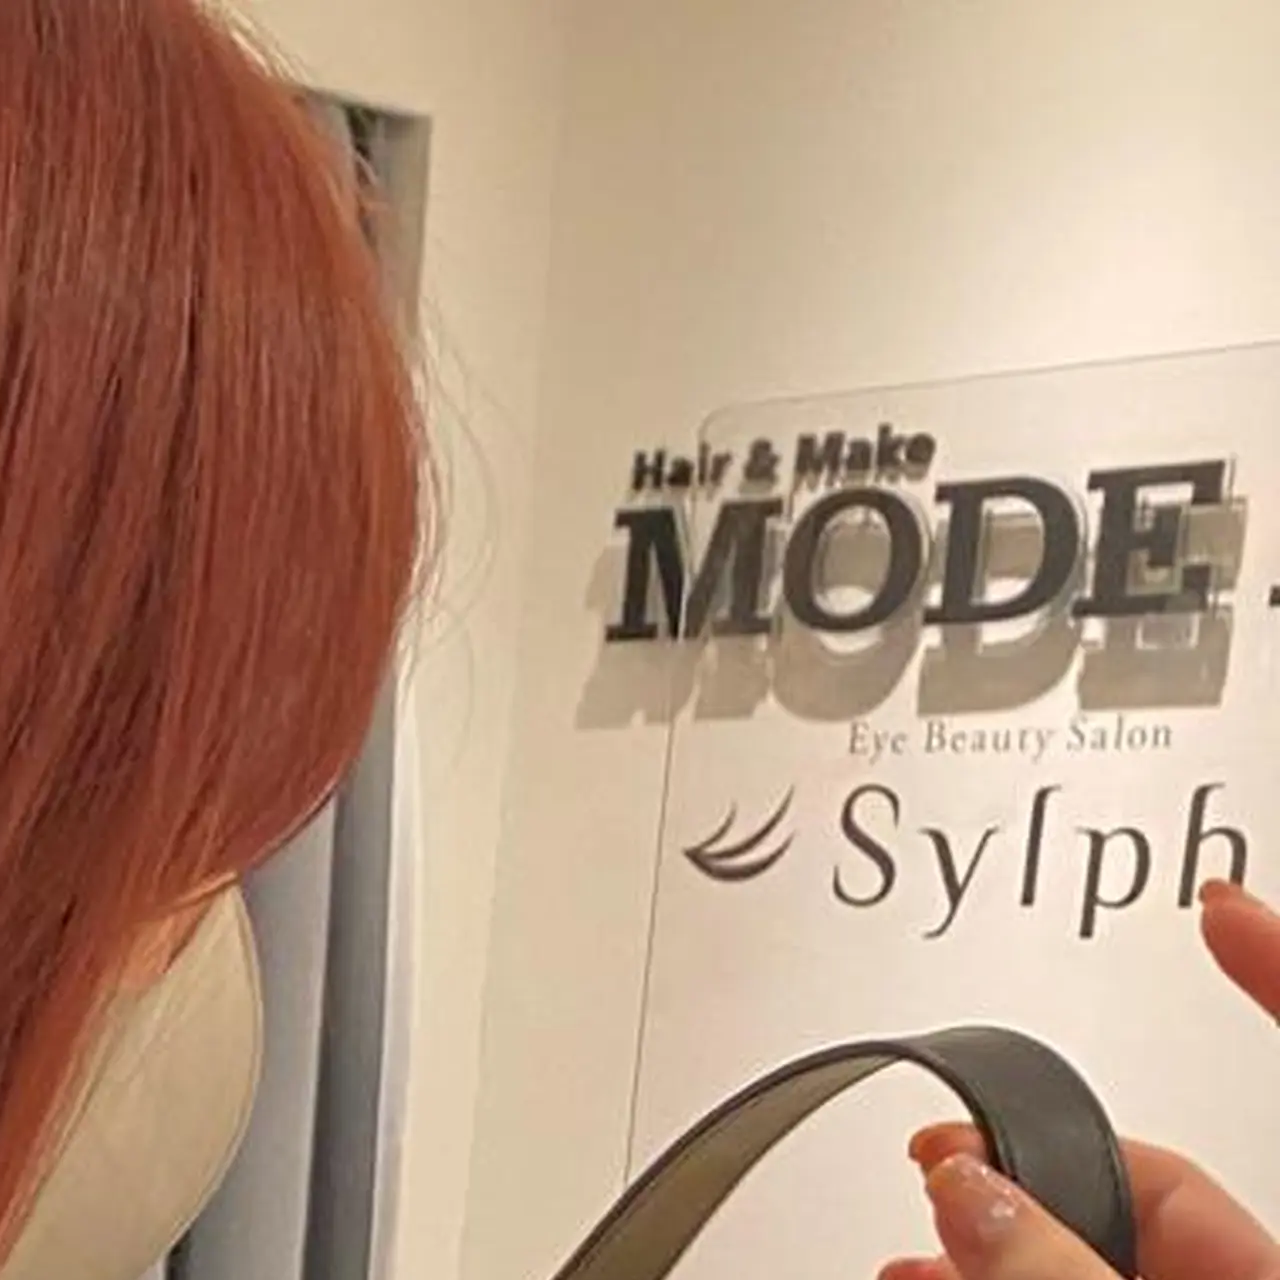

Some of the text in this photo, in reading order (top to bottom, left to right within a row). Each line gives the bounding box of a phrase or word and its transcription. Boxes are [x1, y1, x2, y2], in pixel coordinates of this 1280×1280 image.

[632, 422, 937, 492] Hair & Make
[605, 459, 1227, 643] MODE
[847, 714, 1173, 766] Eye Beauty Salon
[831, 781, 1249, 939] Sylph
